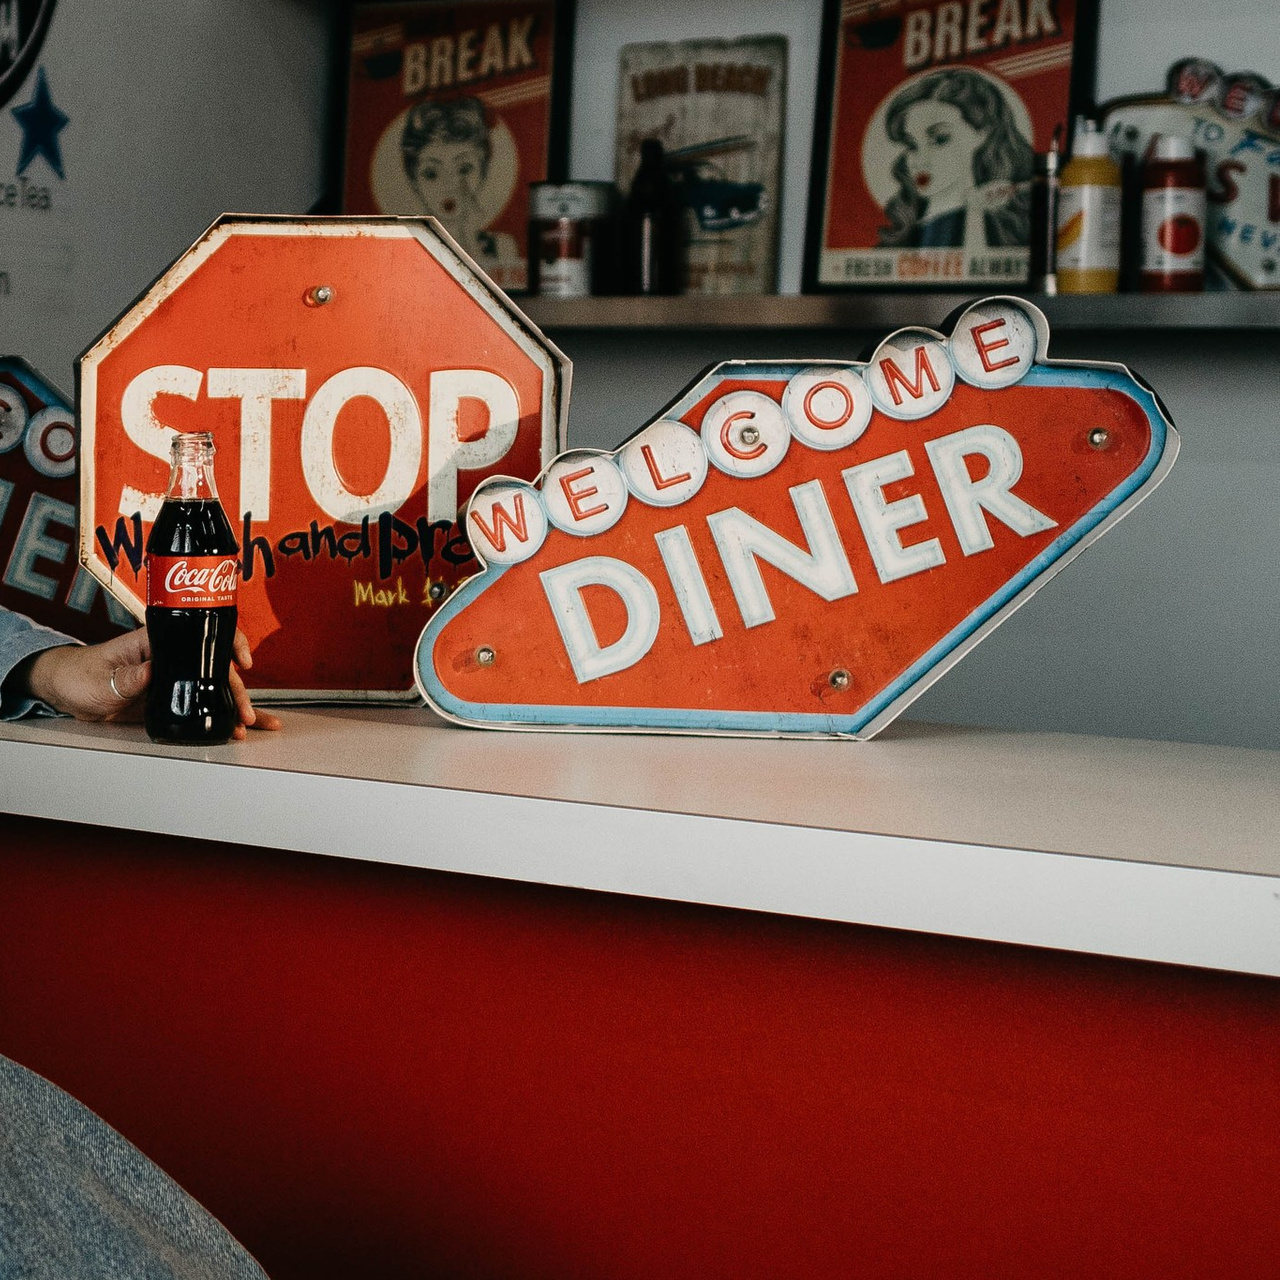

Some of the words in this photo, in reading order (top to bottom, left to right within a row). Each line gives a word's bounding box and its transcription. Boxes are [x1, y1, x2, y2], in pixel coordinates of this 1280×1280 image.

[401, 13, 537, 98] BREAK
[119, 364, 521, 524] STOP
[472, 318, 1020, 552] WELCOME
[96, 511, 274, 582] Wh
[164, 559, 237, 593] Coca-Cola
[539, 424, 1060, 683] DINER
[181, 595, 215, 603] ORIGINAL
[354, 576, 410, 608] Mark
